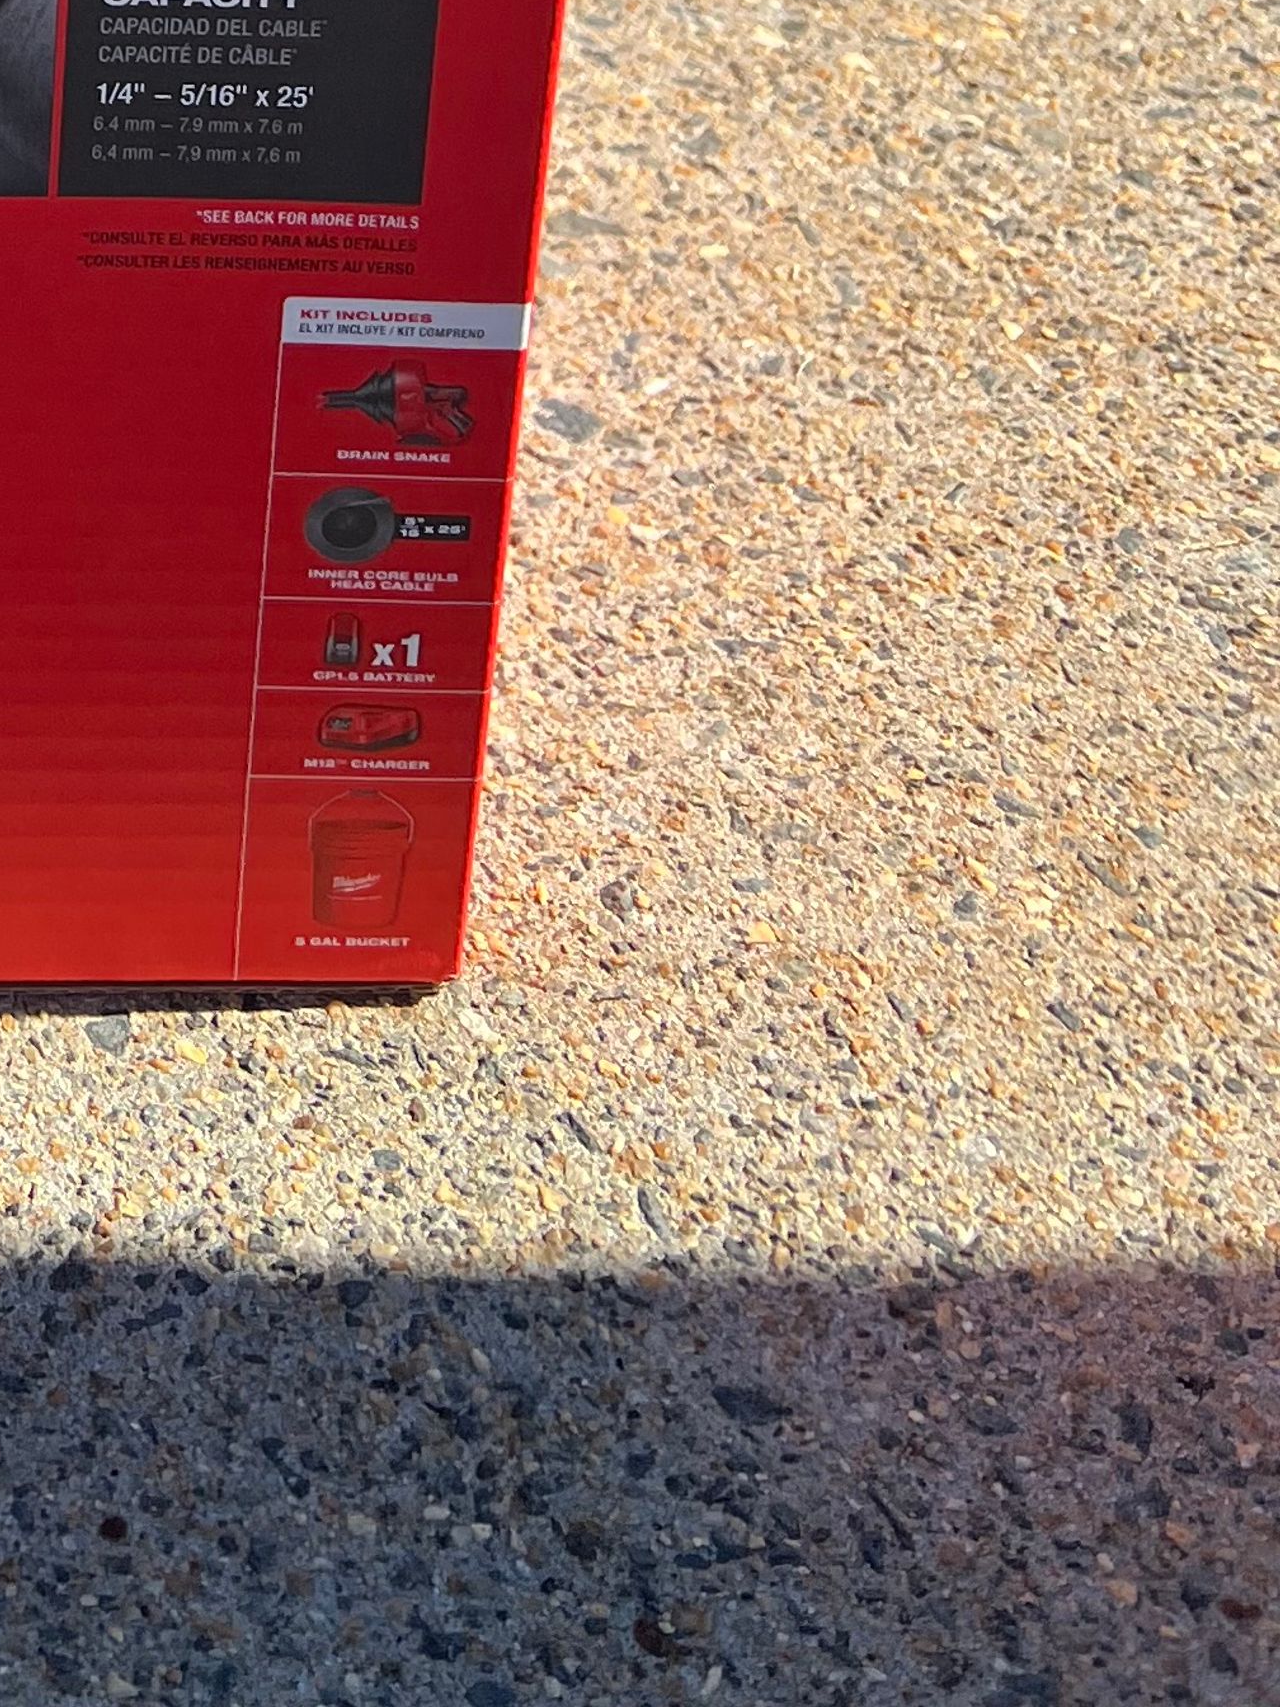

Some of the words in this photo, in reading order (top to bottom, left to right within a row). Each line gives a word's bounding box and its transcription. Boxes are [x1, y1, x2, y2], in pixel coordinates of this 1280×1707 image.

[99, 17, 210, 36] CAPACIDAD
[215, 18, 253, 37] DEL
[98, 42, 192, 64] CAPACITÉ
[196, 45, 223, 64] DE
[96, 82, 145, 106] 1/4"
[180, 83, 248, 107] 5/16"
[255, 90, 269, 107] x
[92, 116, 119, 131] 6.4
[124, 119, 155, 132] mm
[208, 120, 239, 133] mm
[288, 121, 303, 134] m
[123, 147, 154, 161] mm
[206, 149, 237, 163] mm
[285, 150, 301, 164] m
[234, 210, 274, 225] BACK
[278, 211, 307, 225] FOR
[311, 212, 354, 227] MORE
[358, 213, 420, 230] DETAILS
[170, 232, 187, 246] EL
[262, 233, 301, 249] PARA
[172, 255, 200, 269] LES
[342, 259, 363, 274] AU
[365, 259, 416, 276] VERSO
[300, 309, 331, 319] KIT
[336, 310, 433, 323] INCLUDES
[299, 322, 312, 333] EL
[397, 326, 417, 337] KIT
[393, 452, 451, 463] SNAKE
[308, 569, 359, 579] INNER
